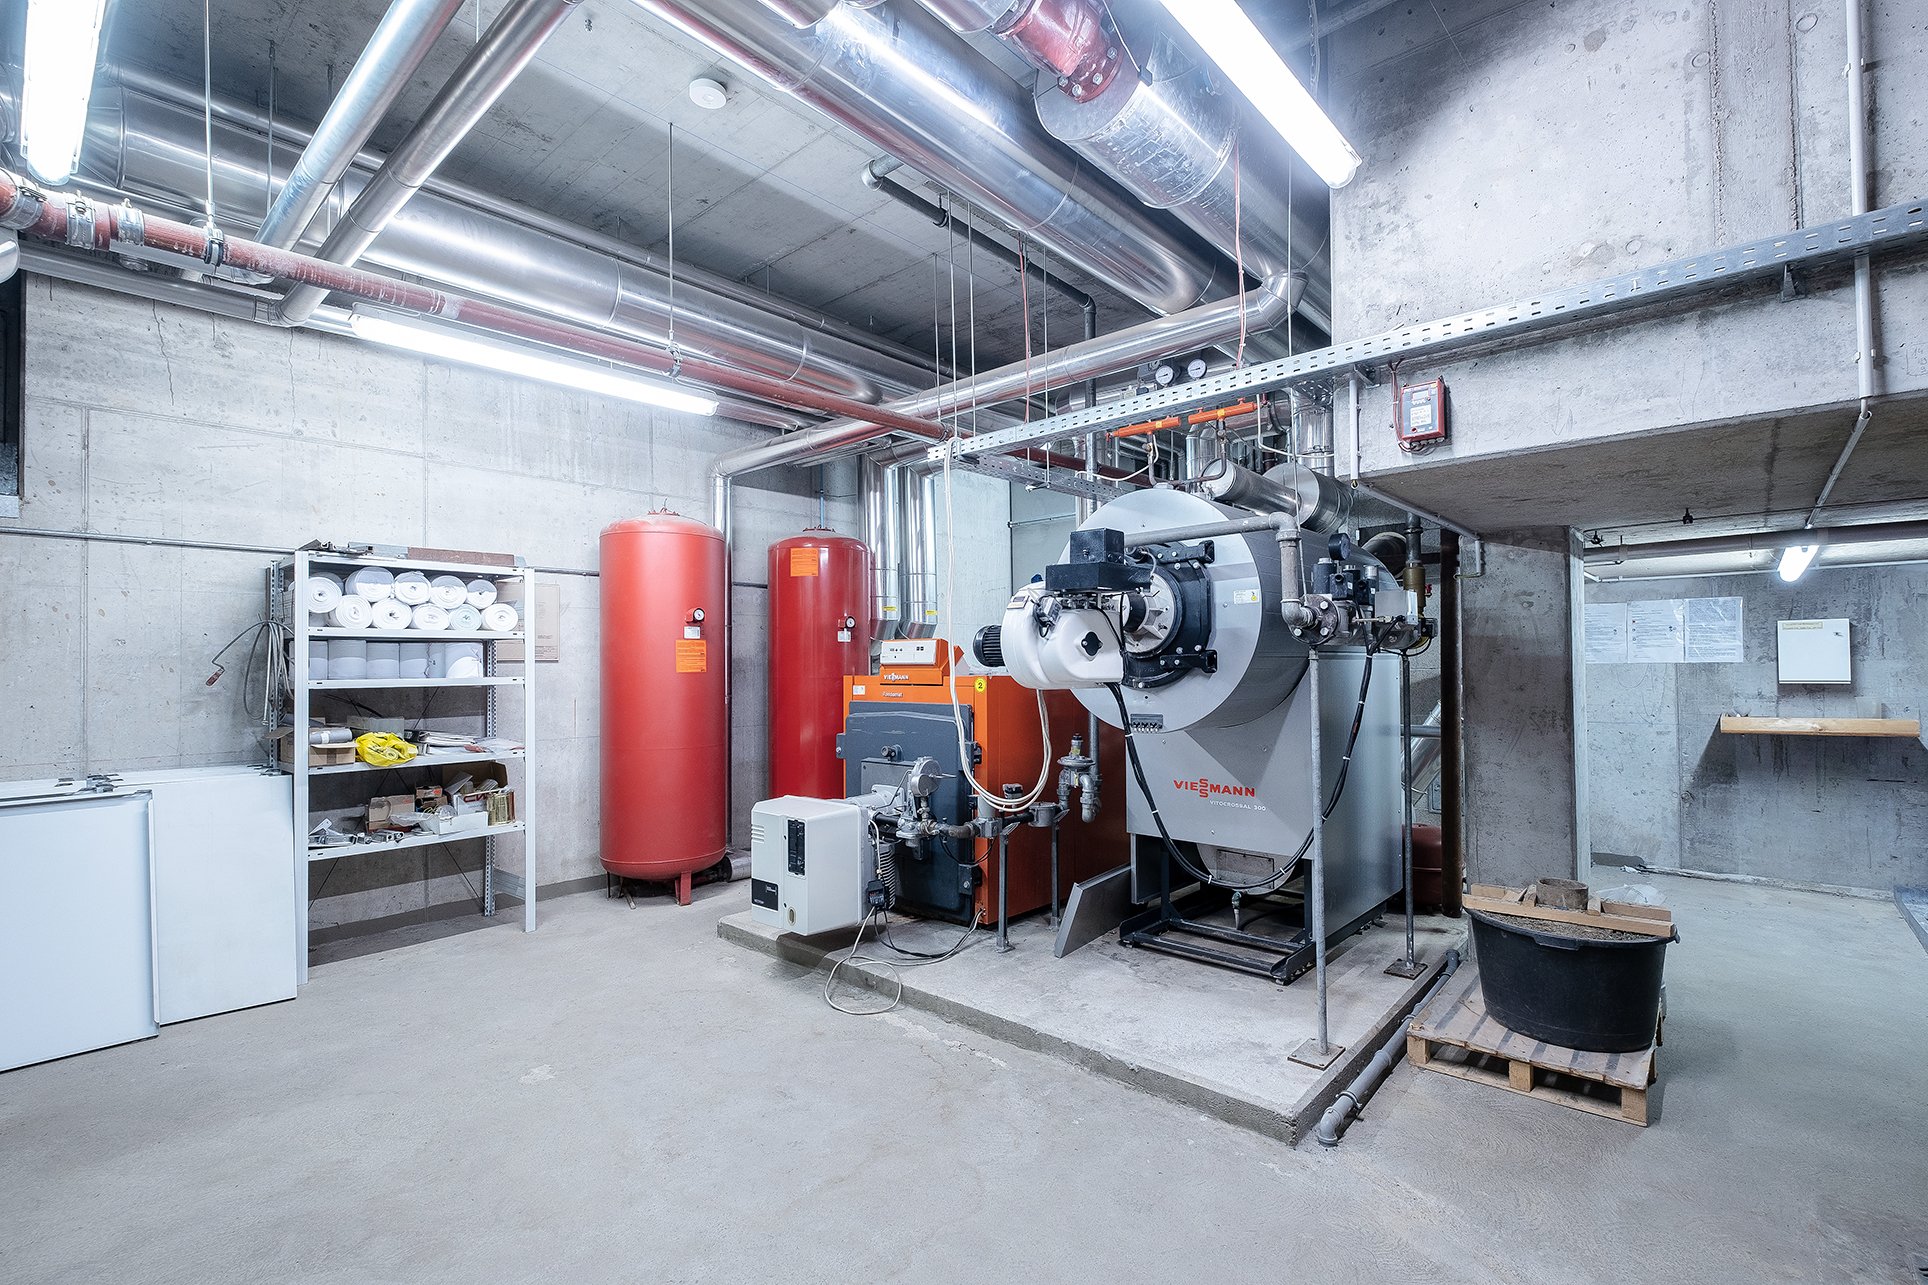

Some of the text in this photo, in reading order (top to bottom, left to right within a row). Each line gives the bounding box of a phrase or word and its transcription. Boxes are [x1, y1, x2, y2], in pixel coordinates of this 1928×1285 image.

[1173, 778, 1256, 798] VIESSMANN
[1209, 800, 1267, 812] VITOCROSSAL 300
